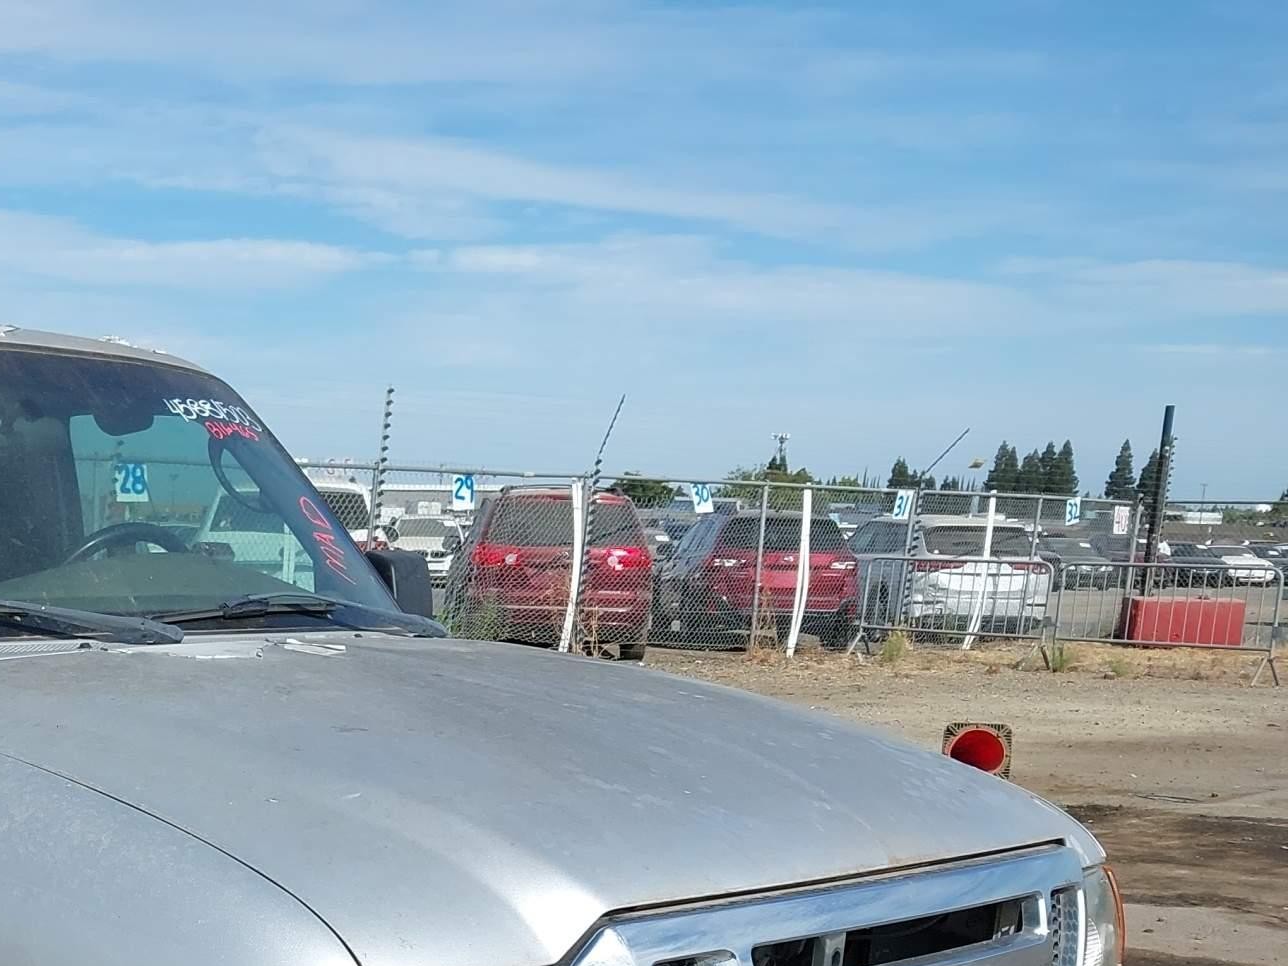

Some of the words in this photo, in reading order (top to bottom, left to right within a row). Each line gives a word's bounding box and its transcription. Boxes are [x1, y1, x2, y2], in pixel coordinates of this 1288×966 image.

[119, 464, 146, 495] 28
[454, 475, 474, 503] 29
[692, 484, 710, 506] 30
[894, 495, 910, 517] 31
[1066, 502, 1081, 522] 32
